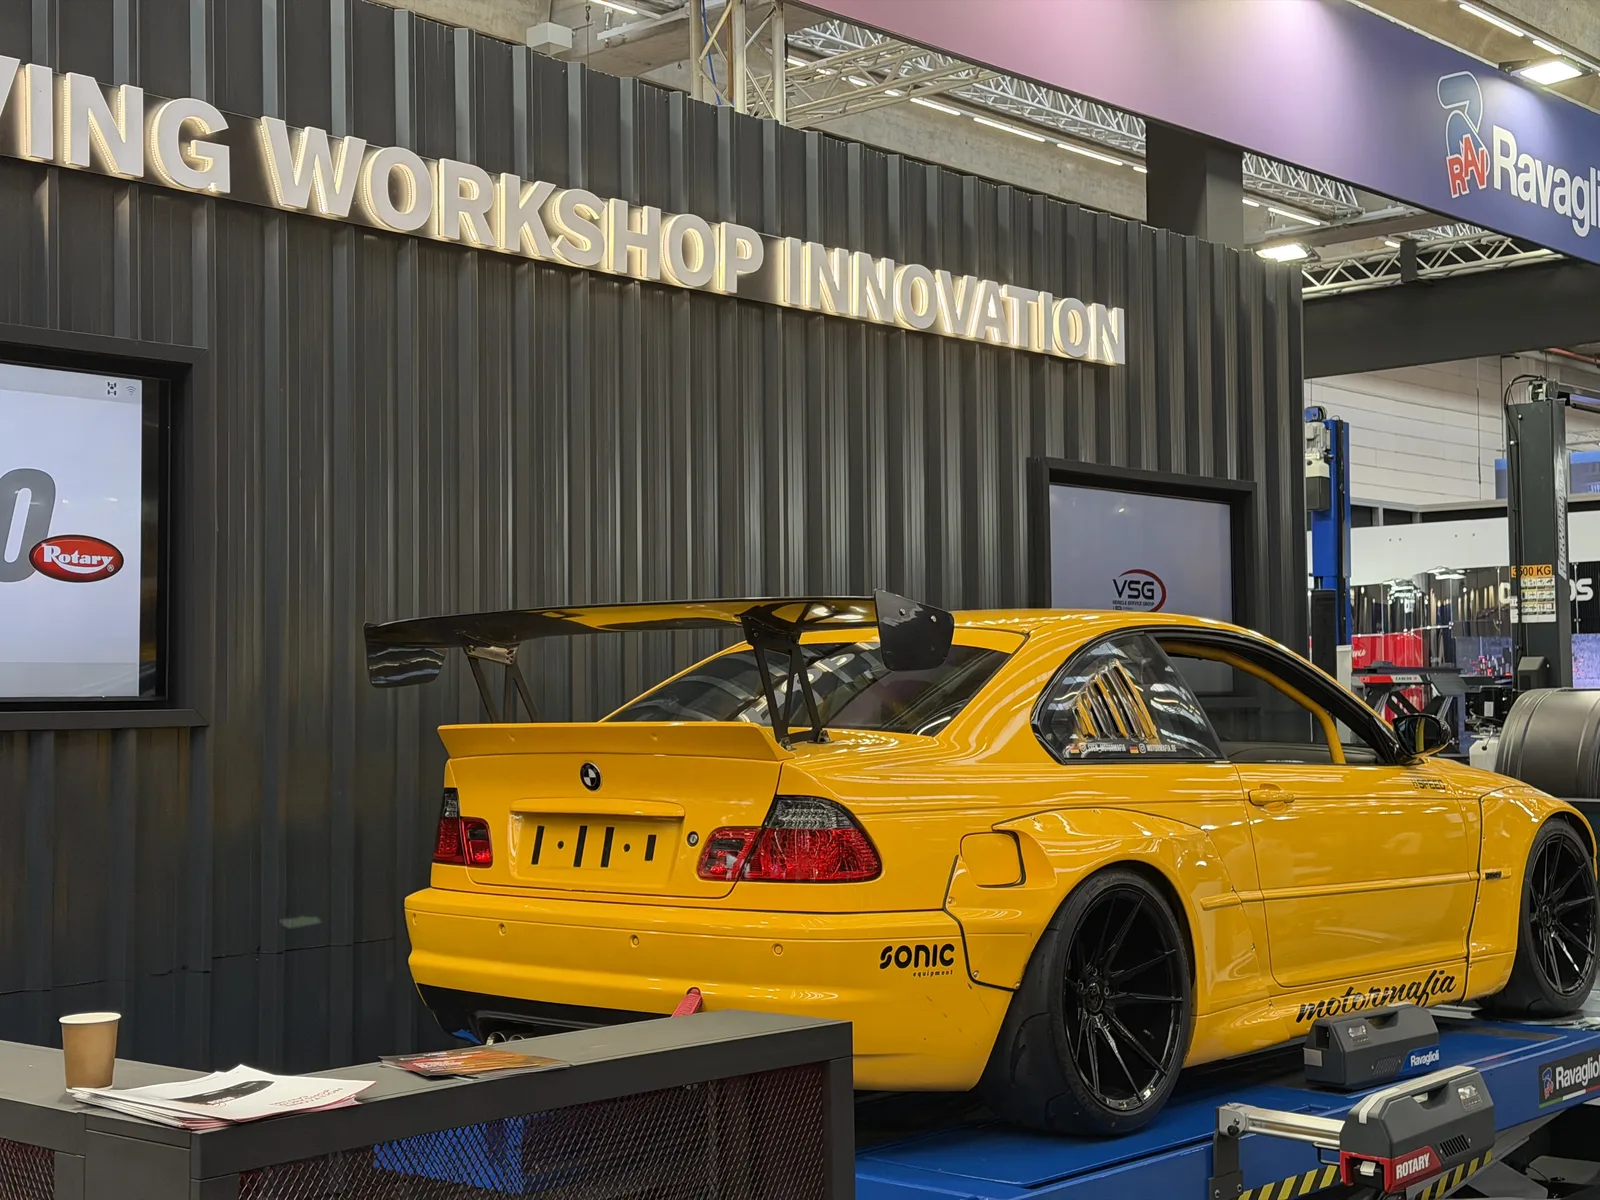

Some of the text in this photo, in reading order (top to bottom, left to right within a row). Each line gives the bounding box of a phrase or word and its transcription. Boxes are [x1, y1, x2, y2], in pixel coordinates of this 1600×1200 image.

[1446, 133, 1487, 198] RAV
[260, 115, 764, 294] WORKSHOP
[783, 236, 1125, 366] INNOVATION
[41, 543, 114, 574] Rotary
[1536, 565, 1551, 576] KG
[1112, 579, 1155, 600] VSG
[913, 969, 953, 978] equipment
[1296, 969, 1457, 1024] motormafia
[1395, 1151, 1431, 1180] ROTARY
